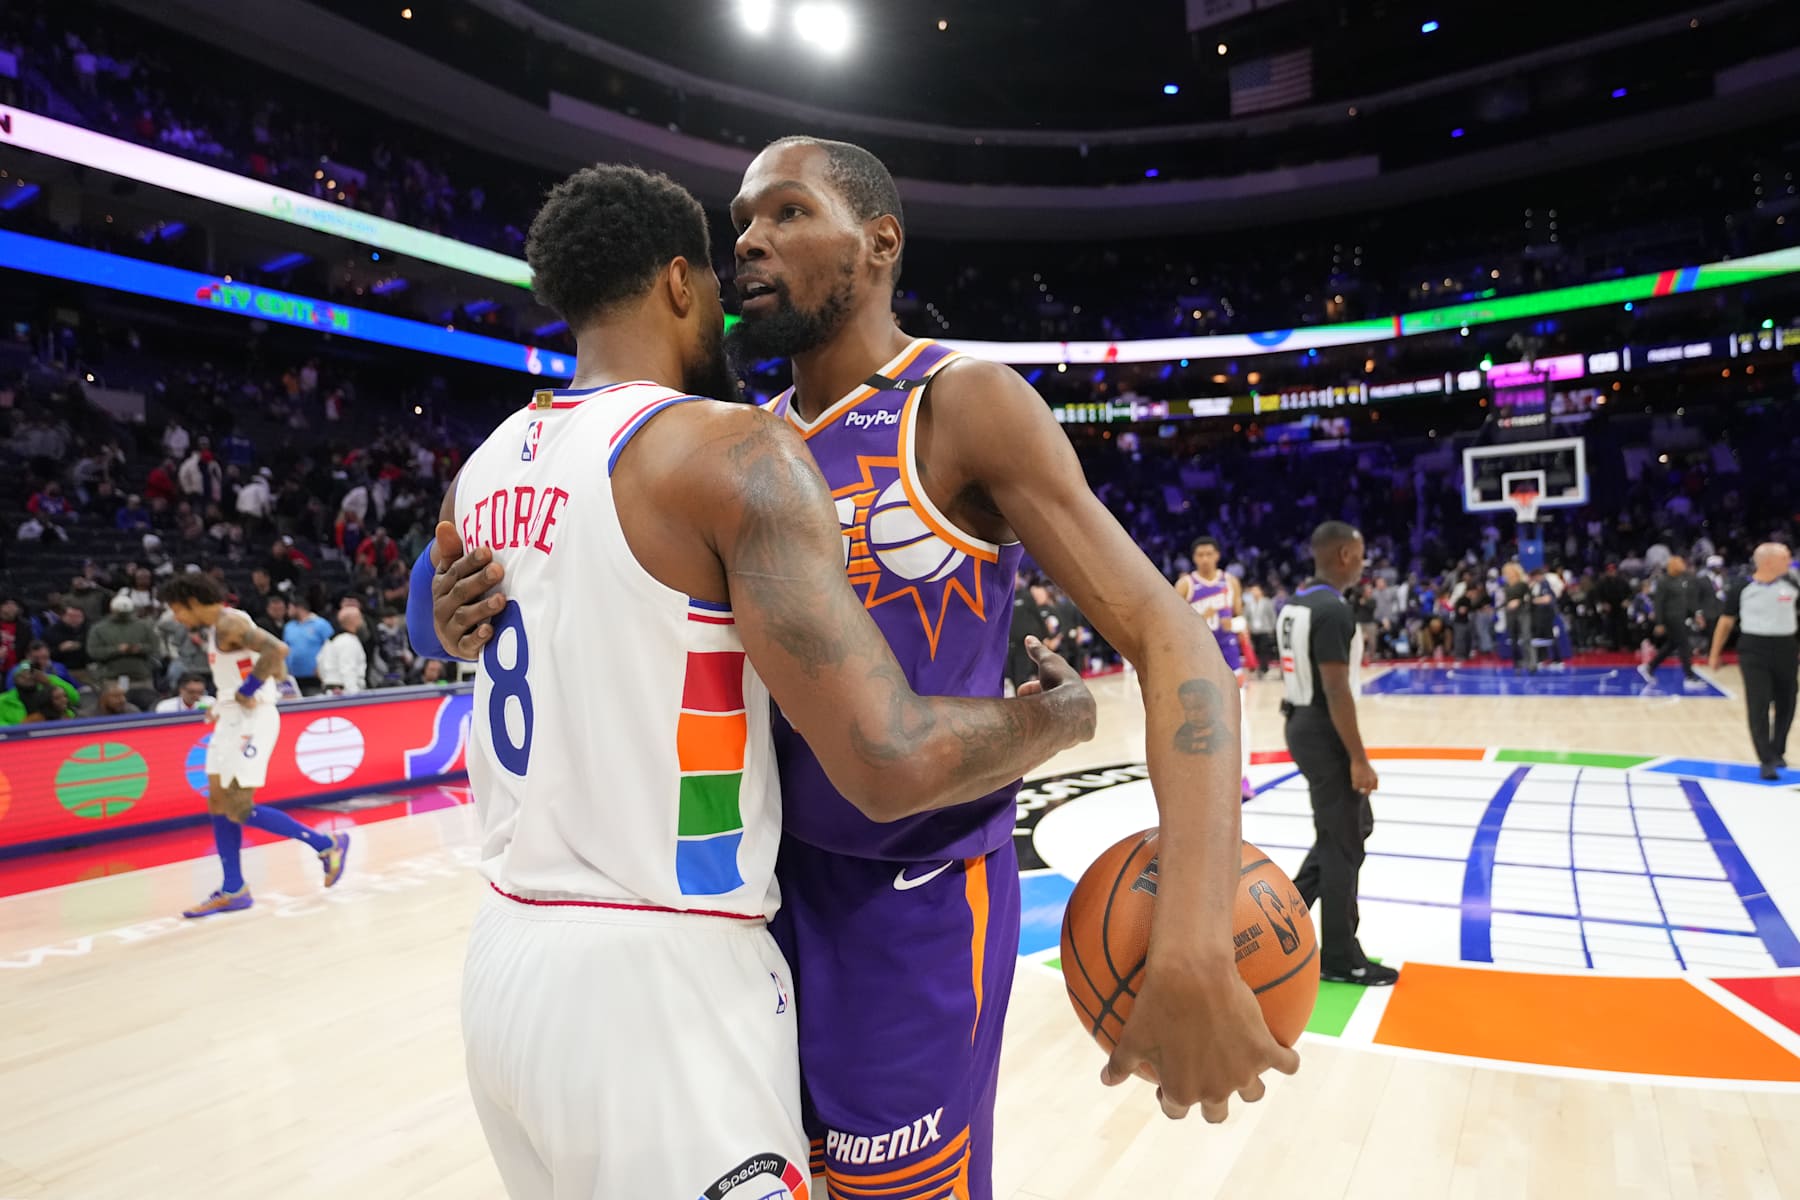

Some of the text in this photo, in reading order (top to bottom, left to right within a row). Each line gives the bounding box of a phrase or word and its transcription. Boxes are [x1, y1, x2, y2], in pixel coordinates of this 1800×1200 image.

[255, 293, 349, 330] EDITIN
[846, 410, 901, 429] PayPal
[484, 599, 534, 777] 8
[827, 1107, 944, 1165] PHOENIX
[718, 1159, 779, 1194] Spectrum
